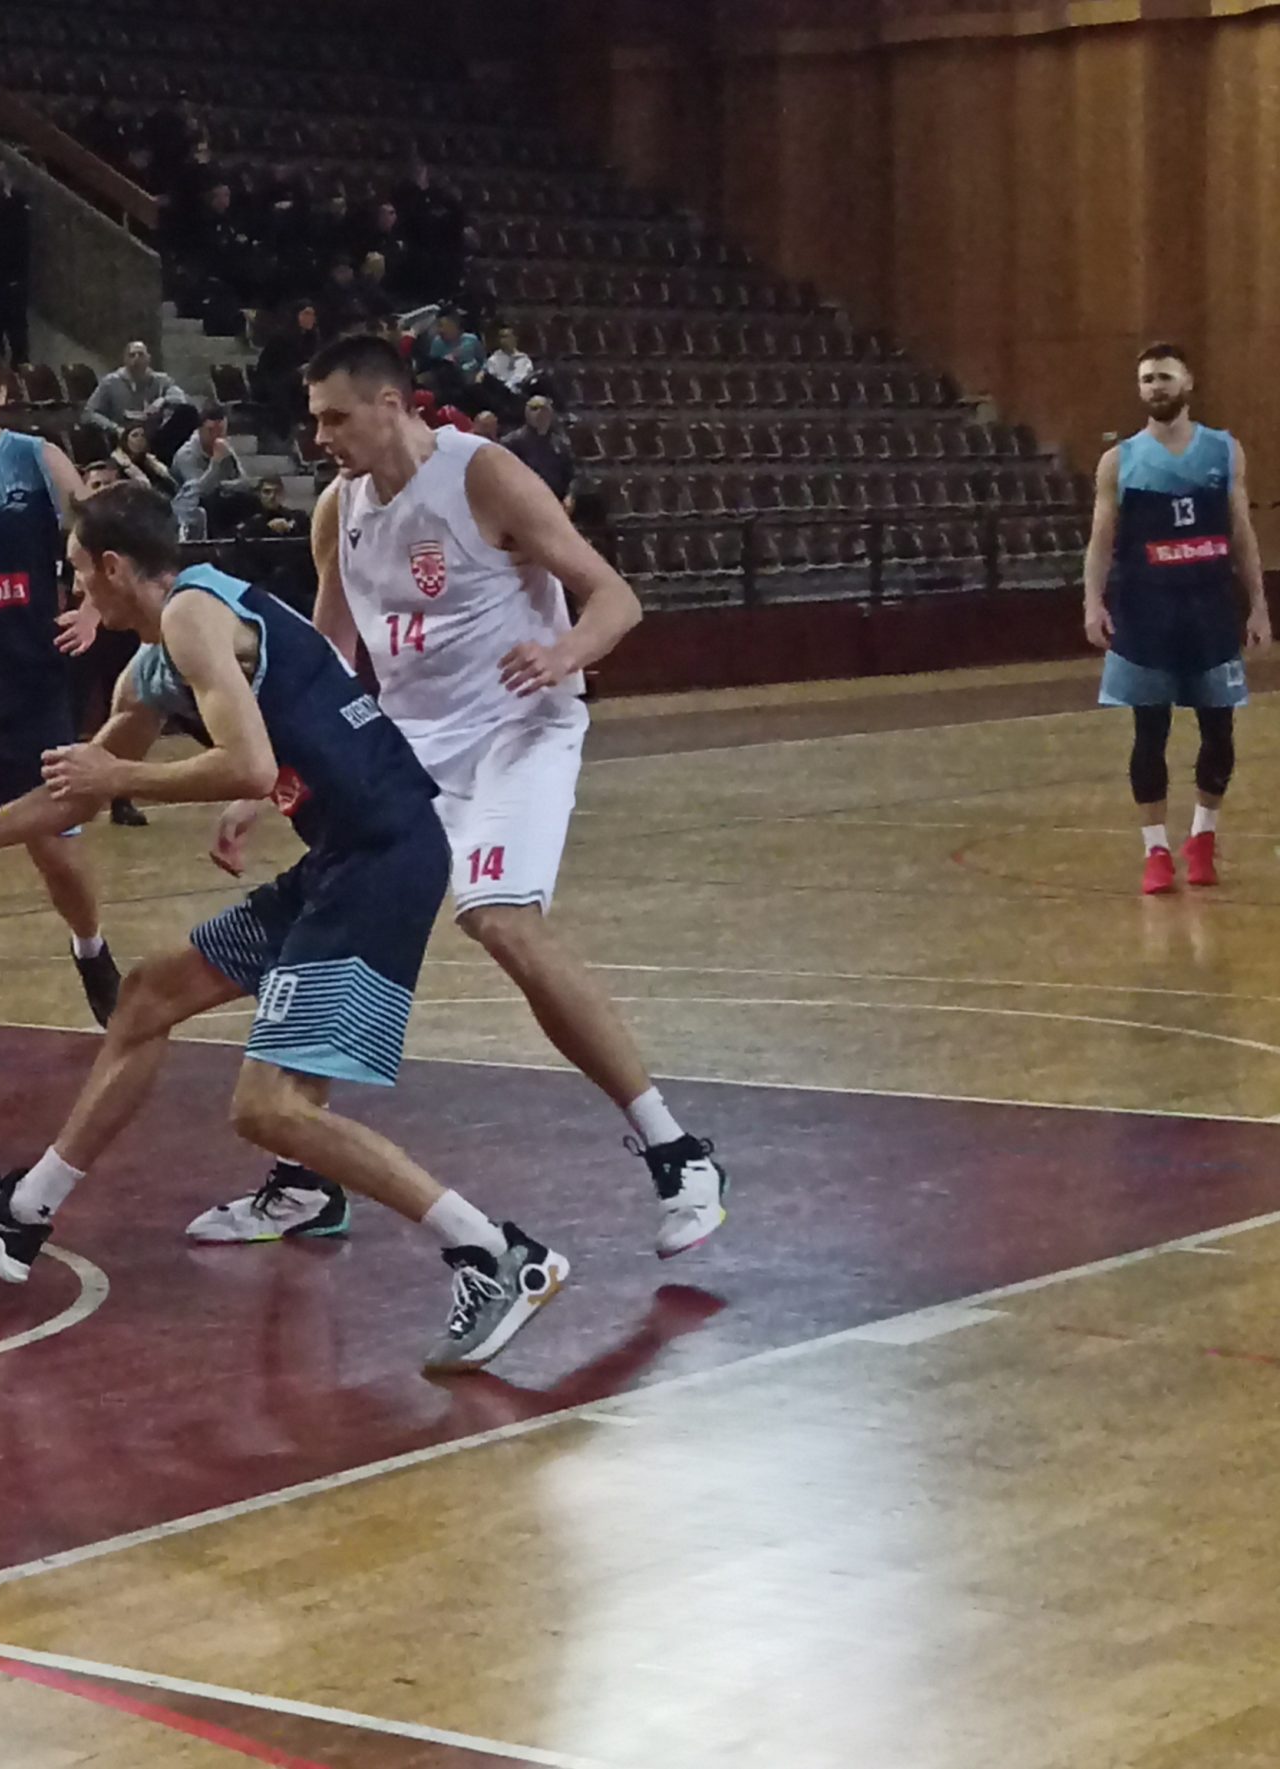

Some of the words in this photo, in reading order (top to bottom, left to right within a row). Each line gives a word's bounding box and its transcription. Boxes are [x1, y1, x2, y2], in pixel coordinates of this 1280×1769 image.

[1172, 497, 1195, 527] 13
[386, 611, 426, 656] 14
[467, 846, 505, 884] 14
[257, 969, 299, 1023] 10
